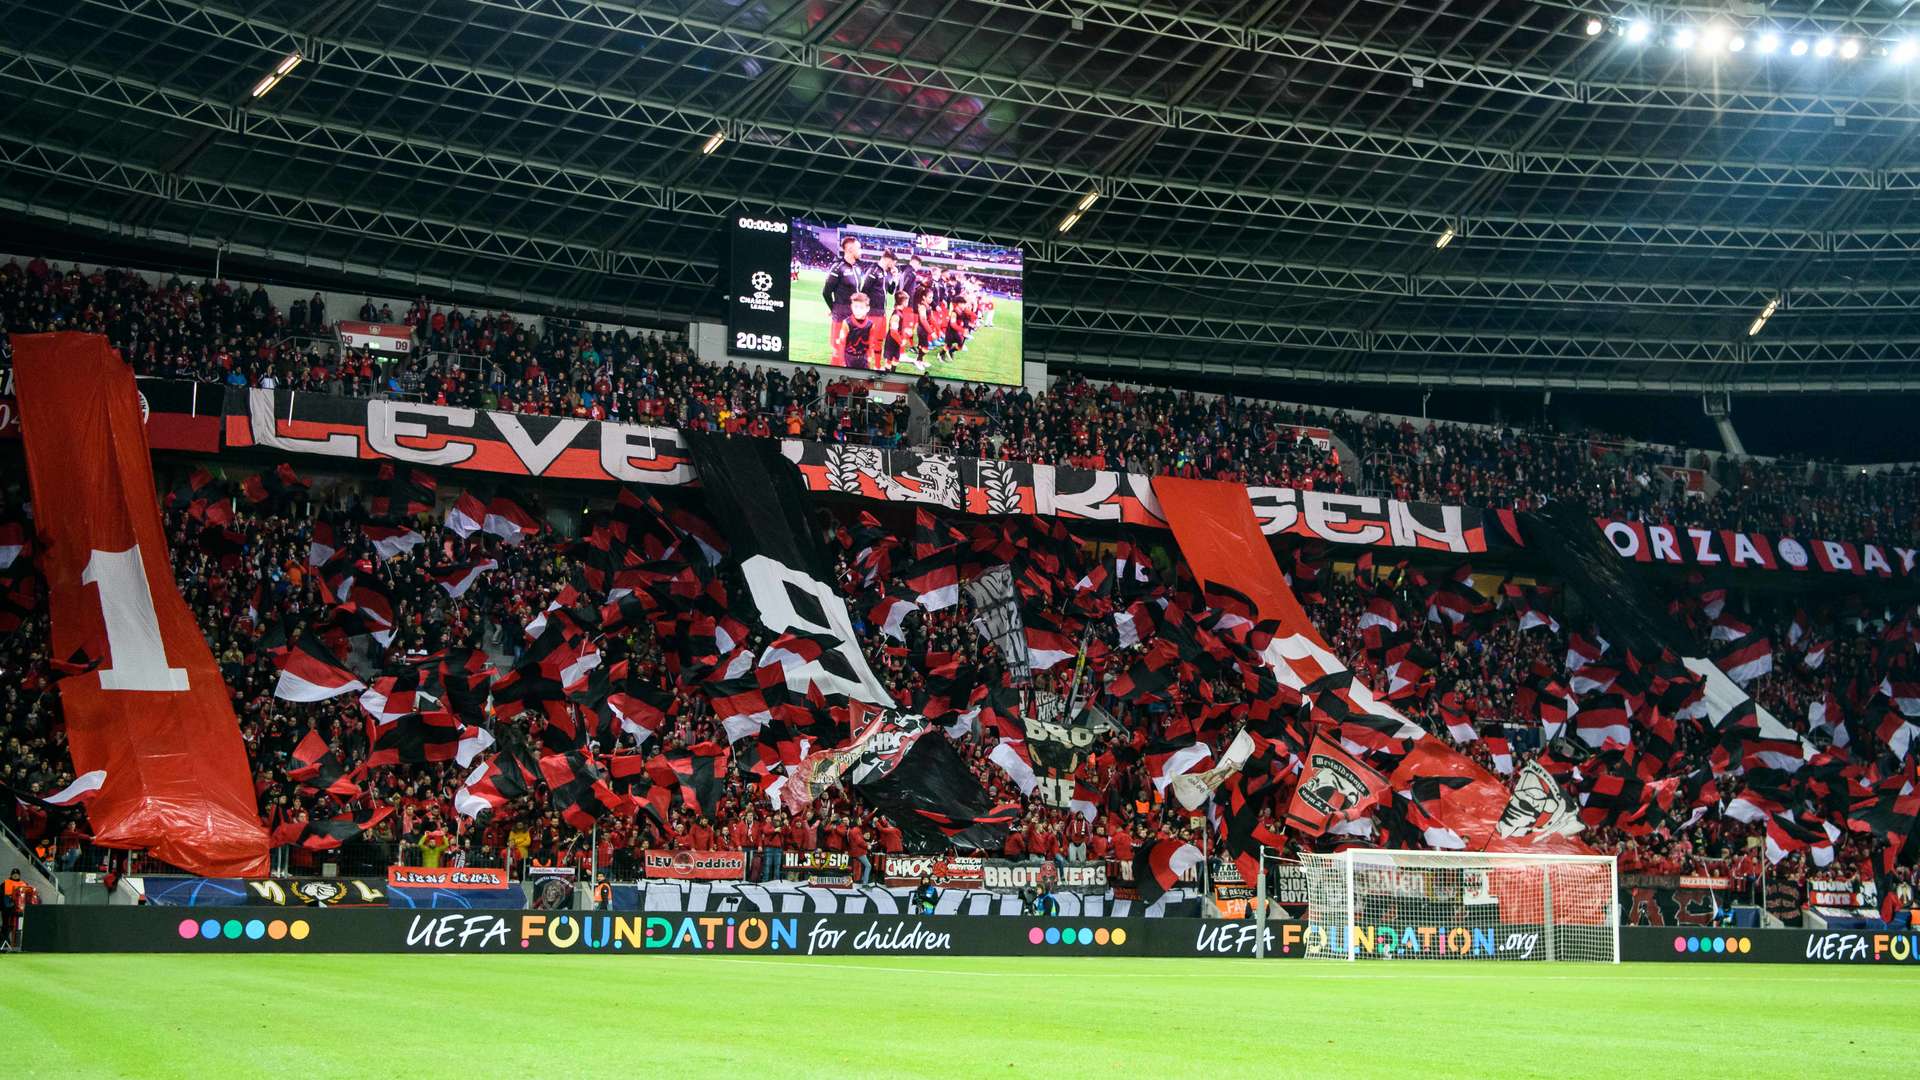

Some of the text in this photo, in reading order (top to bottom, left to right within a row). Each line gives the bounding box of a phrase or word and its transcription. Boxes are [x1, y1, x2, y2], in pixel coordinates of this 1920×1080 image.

[739, 218, 788, 234] 00:00:30
[739, 296, 785, 308] CHAMPIONS
[750, 303, 775, 312] LEAGUE
[736, 332, 782, 352] 20:59
[82, 543, 191, 692] 1
[647, 856, 742, 870] LEV addicts
[886, 859, 931, 877] CHAOS
[1228, 889, 1256, 897] RESPEC
[406, 914, 951, 955] UEFA FOUNDATION for children
[1197, 923, 1276, 953] UEFA
[1282, 924, 1495, 956] FOUNDATION
[1805, 933, 1868, 960] UEFA
